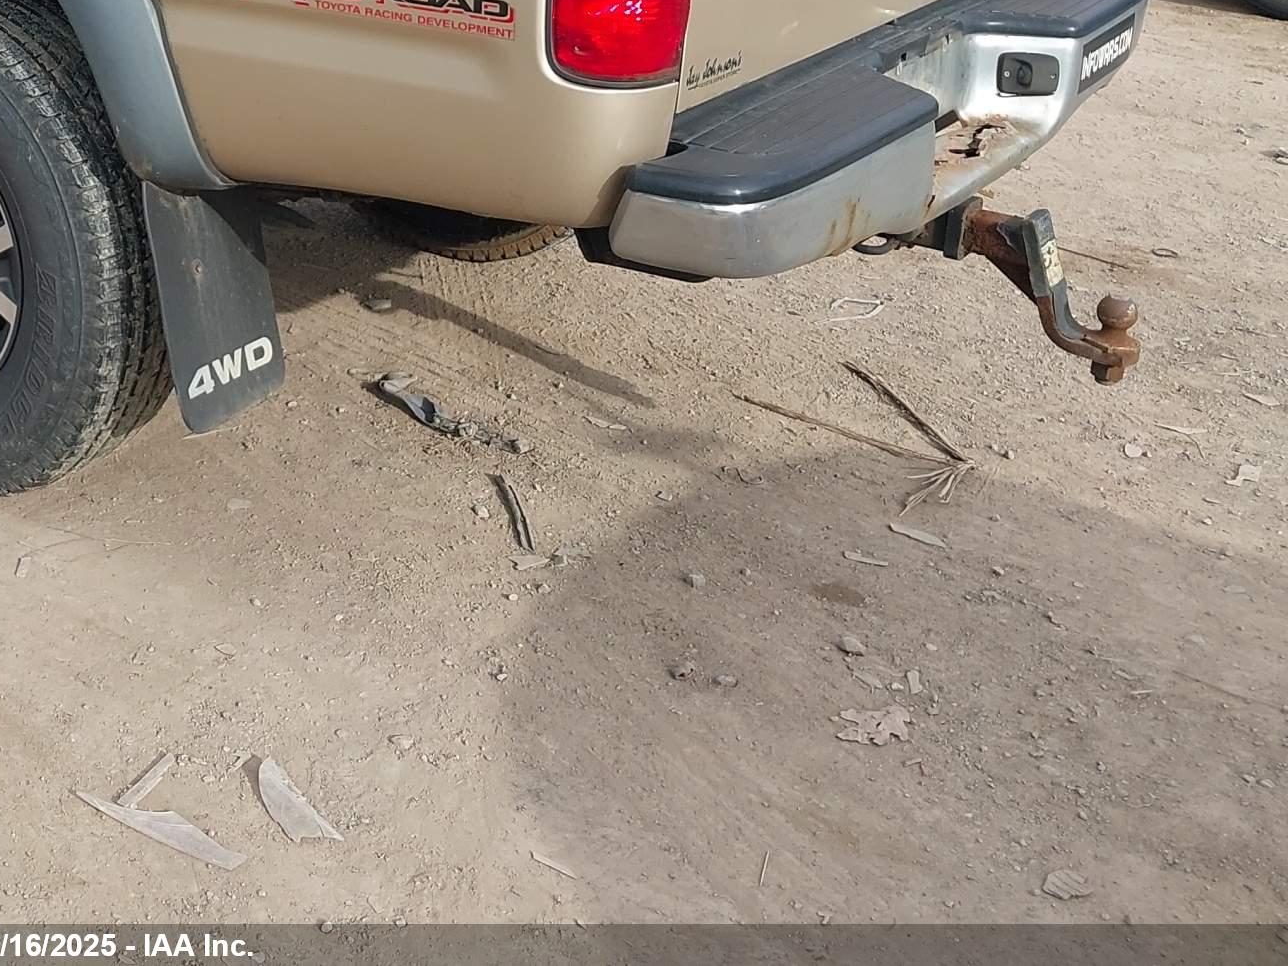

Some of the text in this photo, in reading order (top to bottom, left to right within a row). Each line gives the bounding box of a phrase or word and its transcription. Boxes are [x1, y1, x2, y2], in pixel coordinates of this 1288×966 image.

[314, 0, 513, 39] TOYOTA RACING DEVELOPMENT
[1081, 26, 1134, 81] INFOWARS.COM
[188, 336, 273, 400] 4WD
